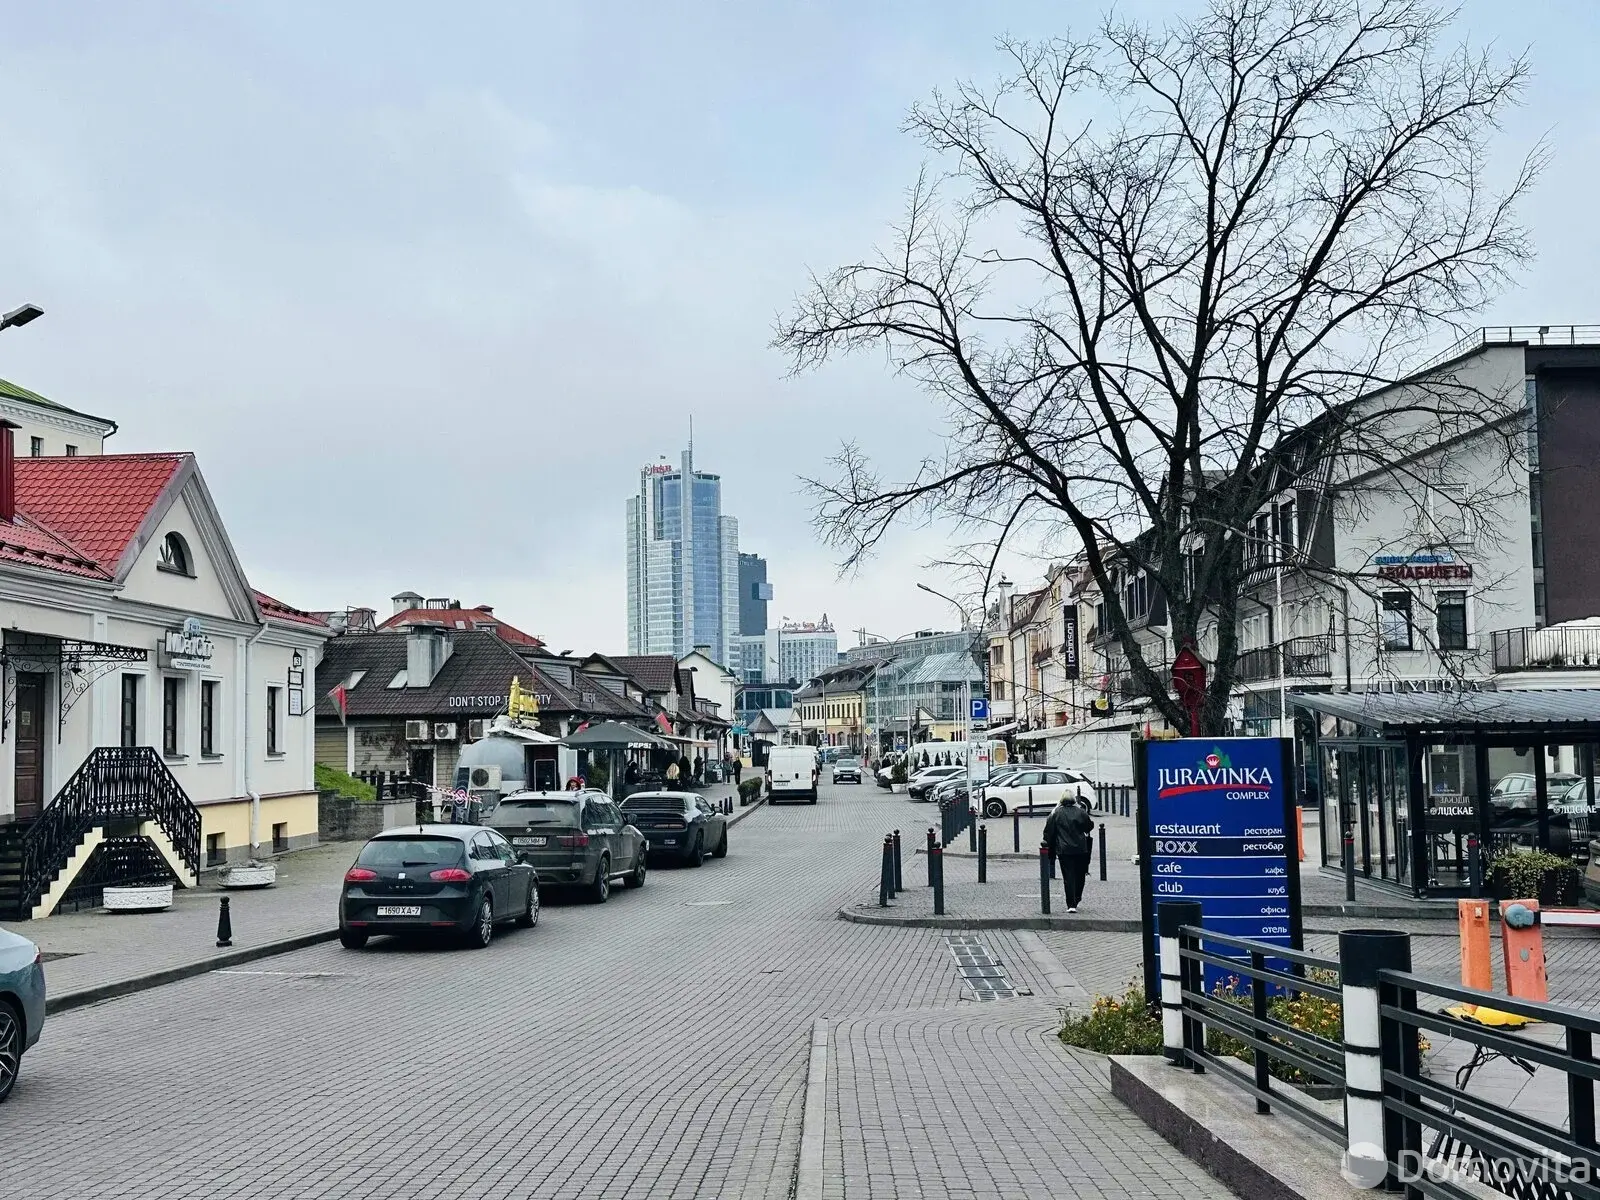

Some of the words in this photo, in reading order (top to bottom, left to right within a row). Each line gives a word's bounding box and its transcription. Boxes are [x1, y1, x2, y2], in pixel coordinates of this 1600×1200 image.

[1066, 622, 1076, 663] robinson
[295, 657, 300, 665] 3
[449, 696, 475, 707] DON'T
[477, 695, 501, 707] STOP
[972, 700, 983, 717] P
[1158, 767, 1273, 791] JURAVINKA
[1226, 791, 1270, 800] COMPLEX
[1437, 806, 1474, 816] ЛІДСКАЕ
[1155, 823, 1221, 835] restaurant
[1244, 828, 1282, 837] ресторан
[1155, 840, 1199, 853] ROXX
[1243, 841, 1284, 852] рестобар
[1157, 862, 1182, 873] cafe
[1265, 866, 1285, 875] кафе
[1158, 881, 1183, 893] club
[1268, 886, 1286, 895] клуб
[1261, 906, 1287, 915] офисы
[1262, 925, 1287, 934] отель
